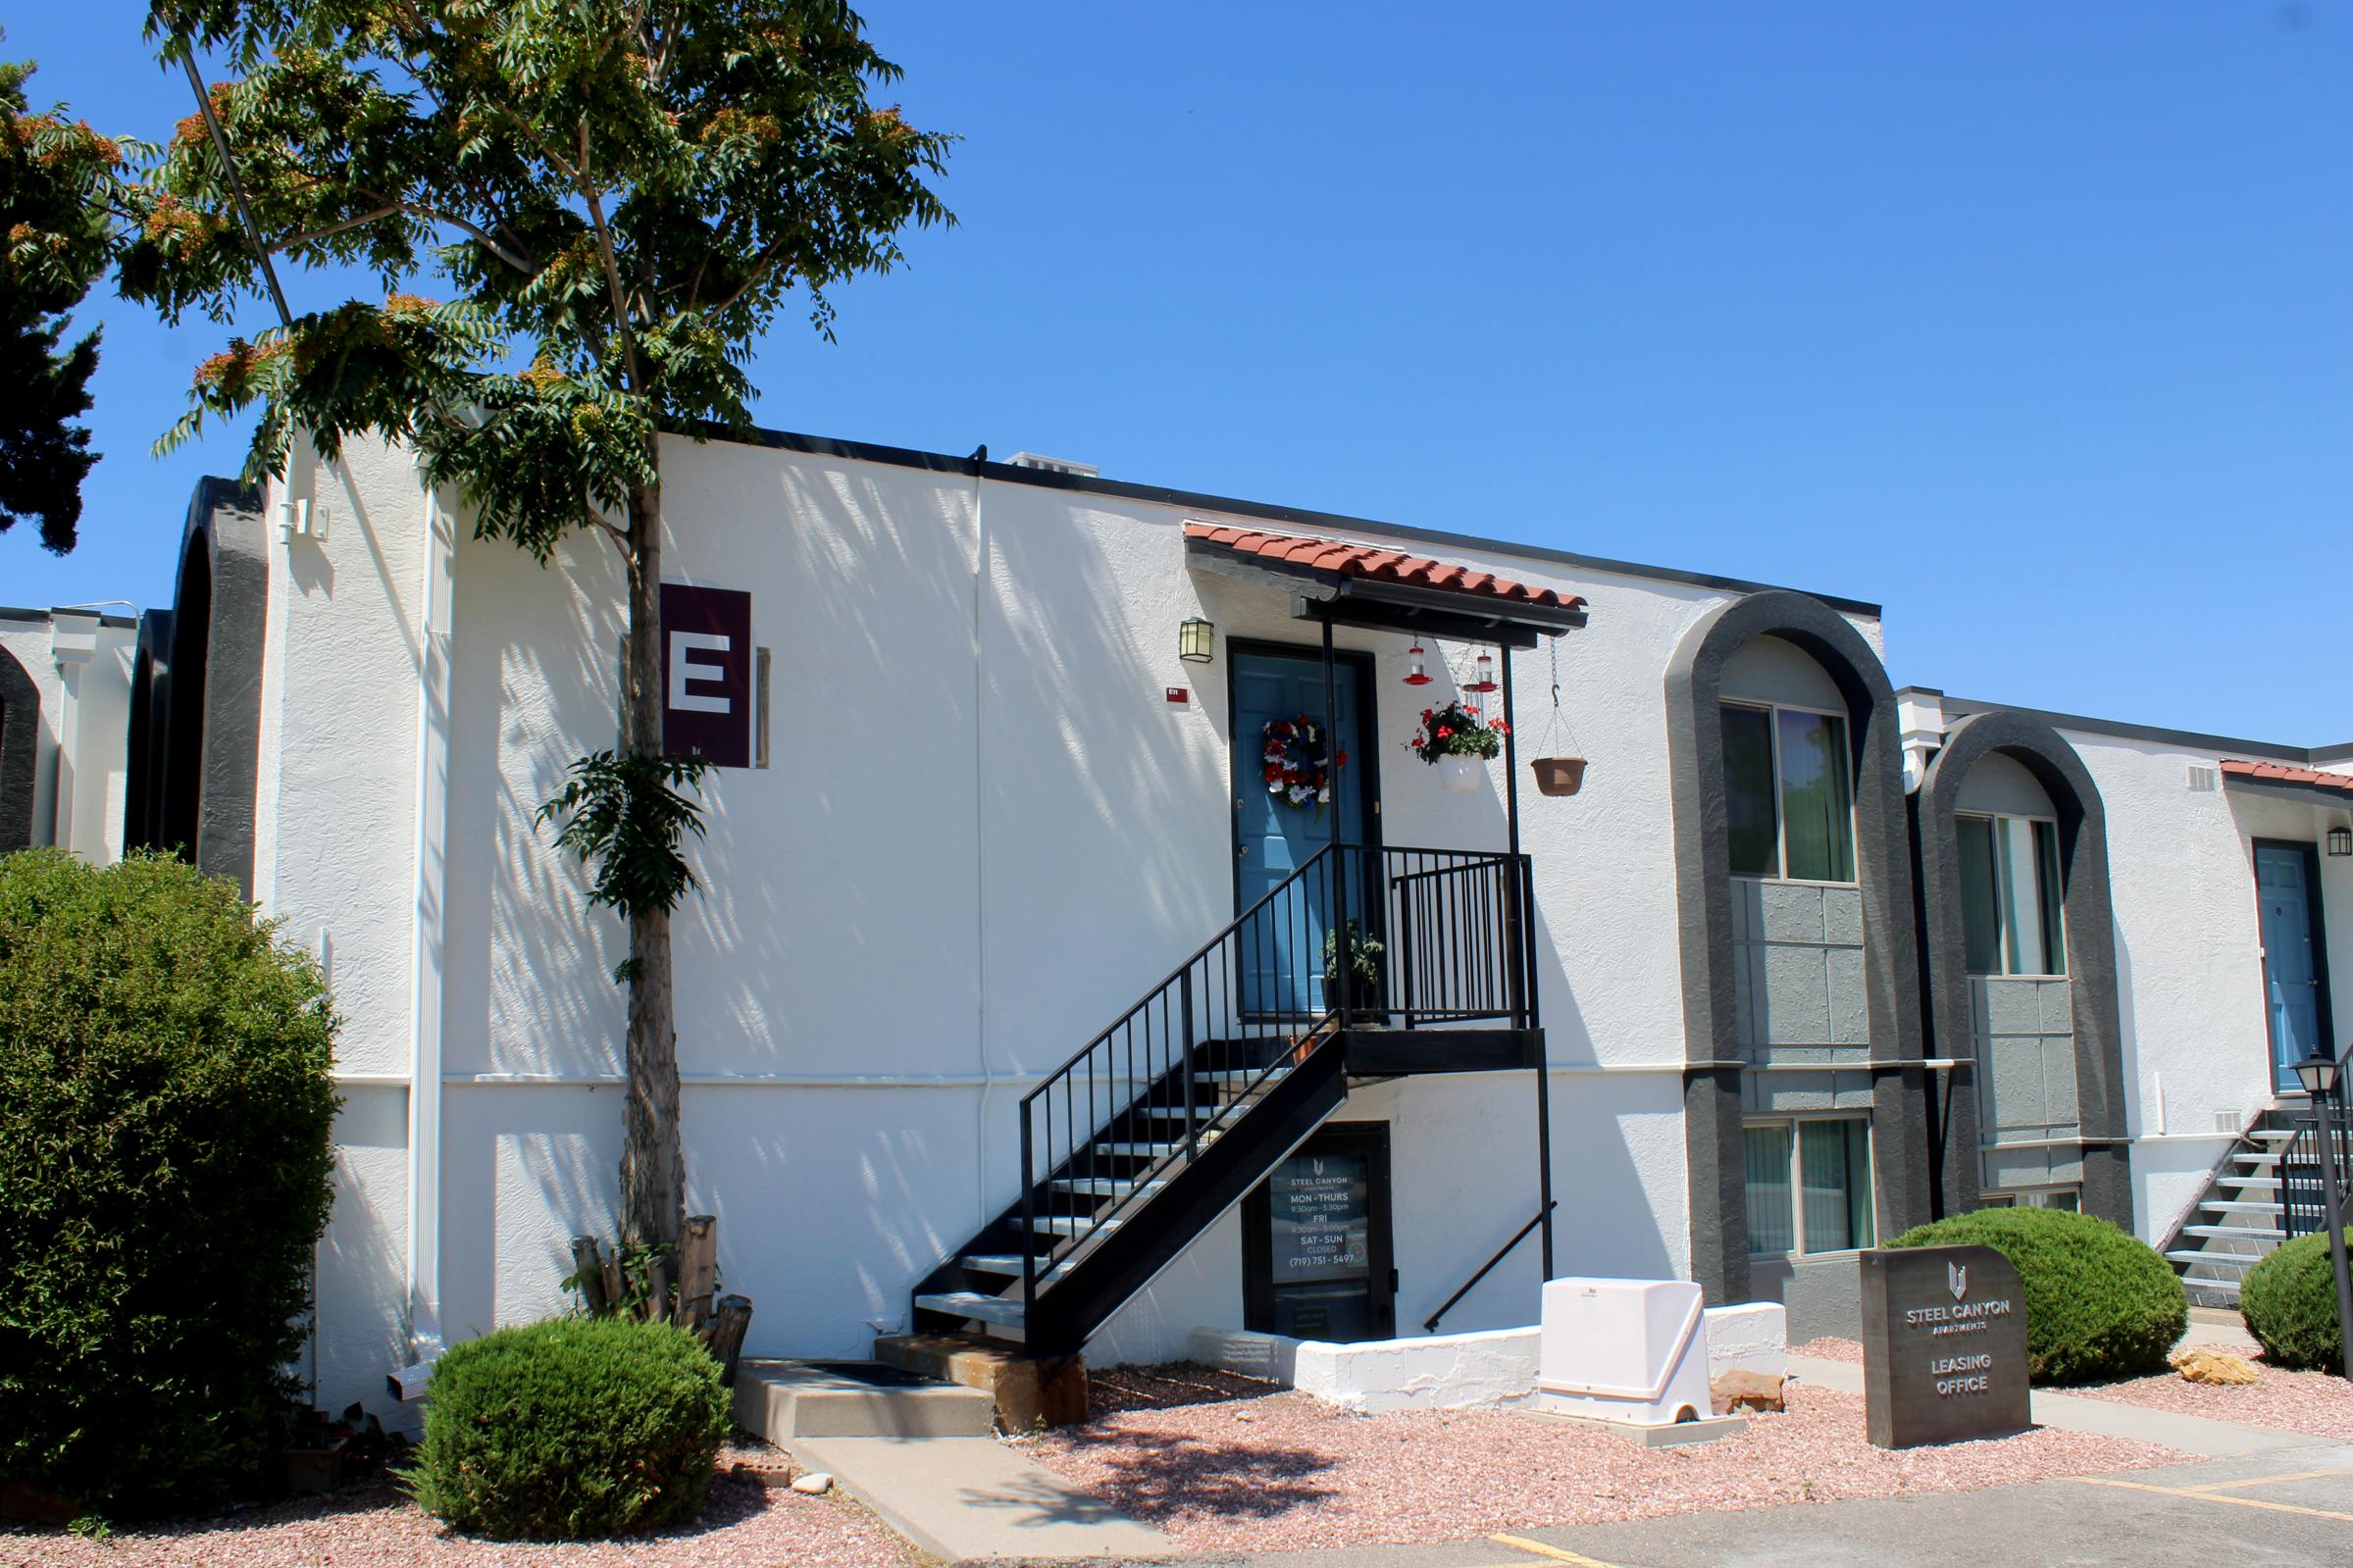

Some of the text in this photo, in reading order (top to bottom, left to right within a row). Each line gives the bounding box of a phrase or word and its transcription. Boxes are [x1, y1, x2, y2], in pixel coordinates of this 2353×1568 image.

[669, 631, 730, 714] E
[1291, 1194, 1312, 1203] MON
[1318, 1192, 1349, 1201] THURS
[1313, 1214, 1327, 1223] FRI
[1301, 1236, 1317, 1244] SAT
[1324, 1235, 1343, 1243] SUN
[1289, 1256, 1311, 1268] (719)
[1312, 1255, 1326, 1265] 751
[1333, 1254, 1354, 1264] 5497
[1907, 1300, 2010, 1324] STEEL CANYON
[1932, 1322, 1987, 1336] APARTMENTS
[1931, 1354, 1991, 1374] LEASING
[1937, 1377, 1988, 1395] OFFICE
